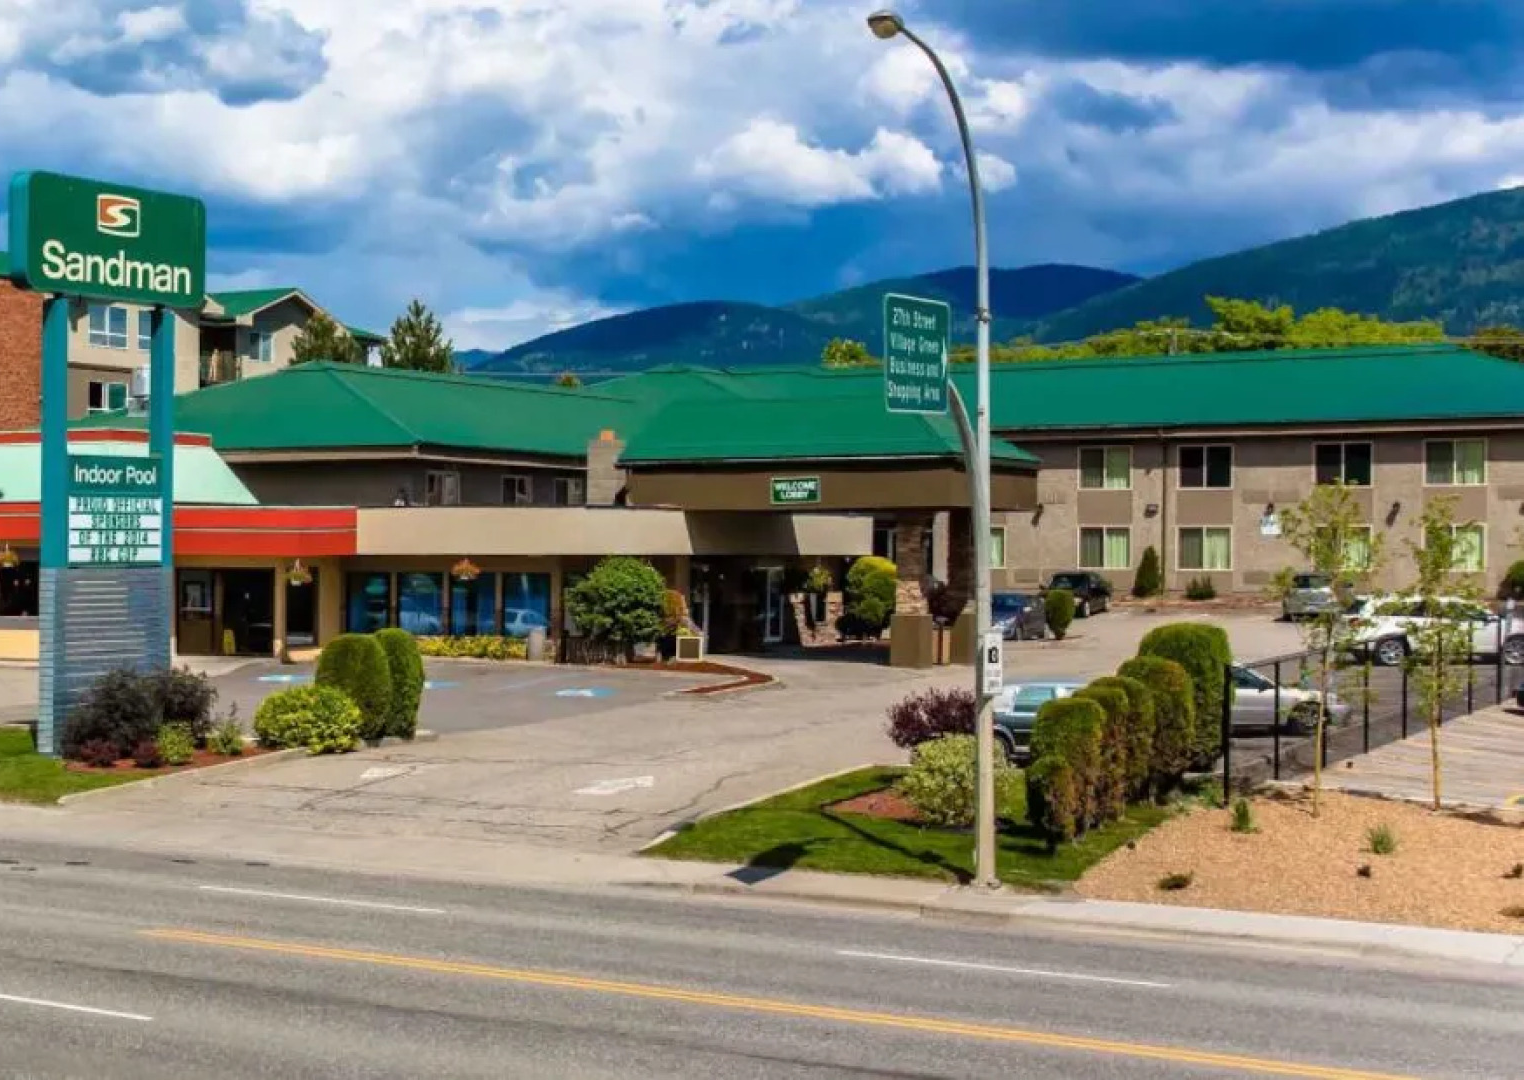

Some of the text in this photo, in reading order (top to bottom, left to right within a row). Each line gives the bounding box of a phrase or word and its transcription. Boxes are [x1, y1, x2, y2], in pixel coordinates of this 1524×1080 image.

[42, 239, 192, 295] Sandman
[892, 307, 936, 330] 27th Street
[74, 463, 157, 485] Indoor Pool
